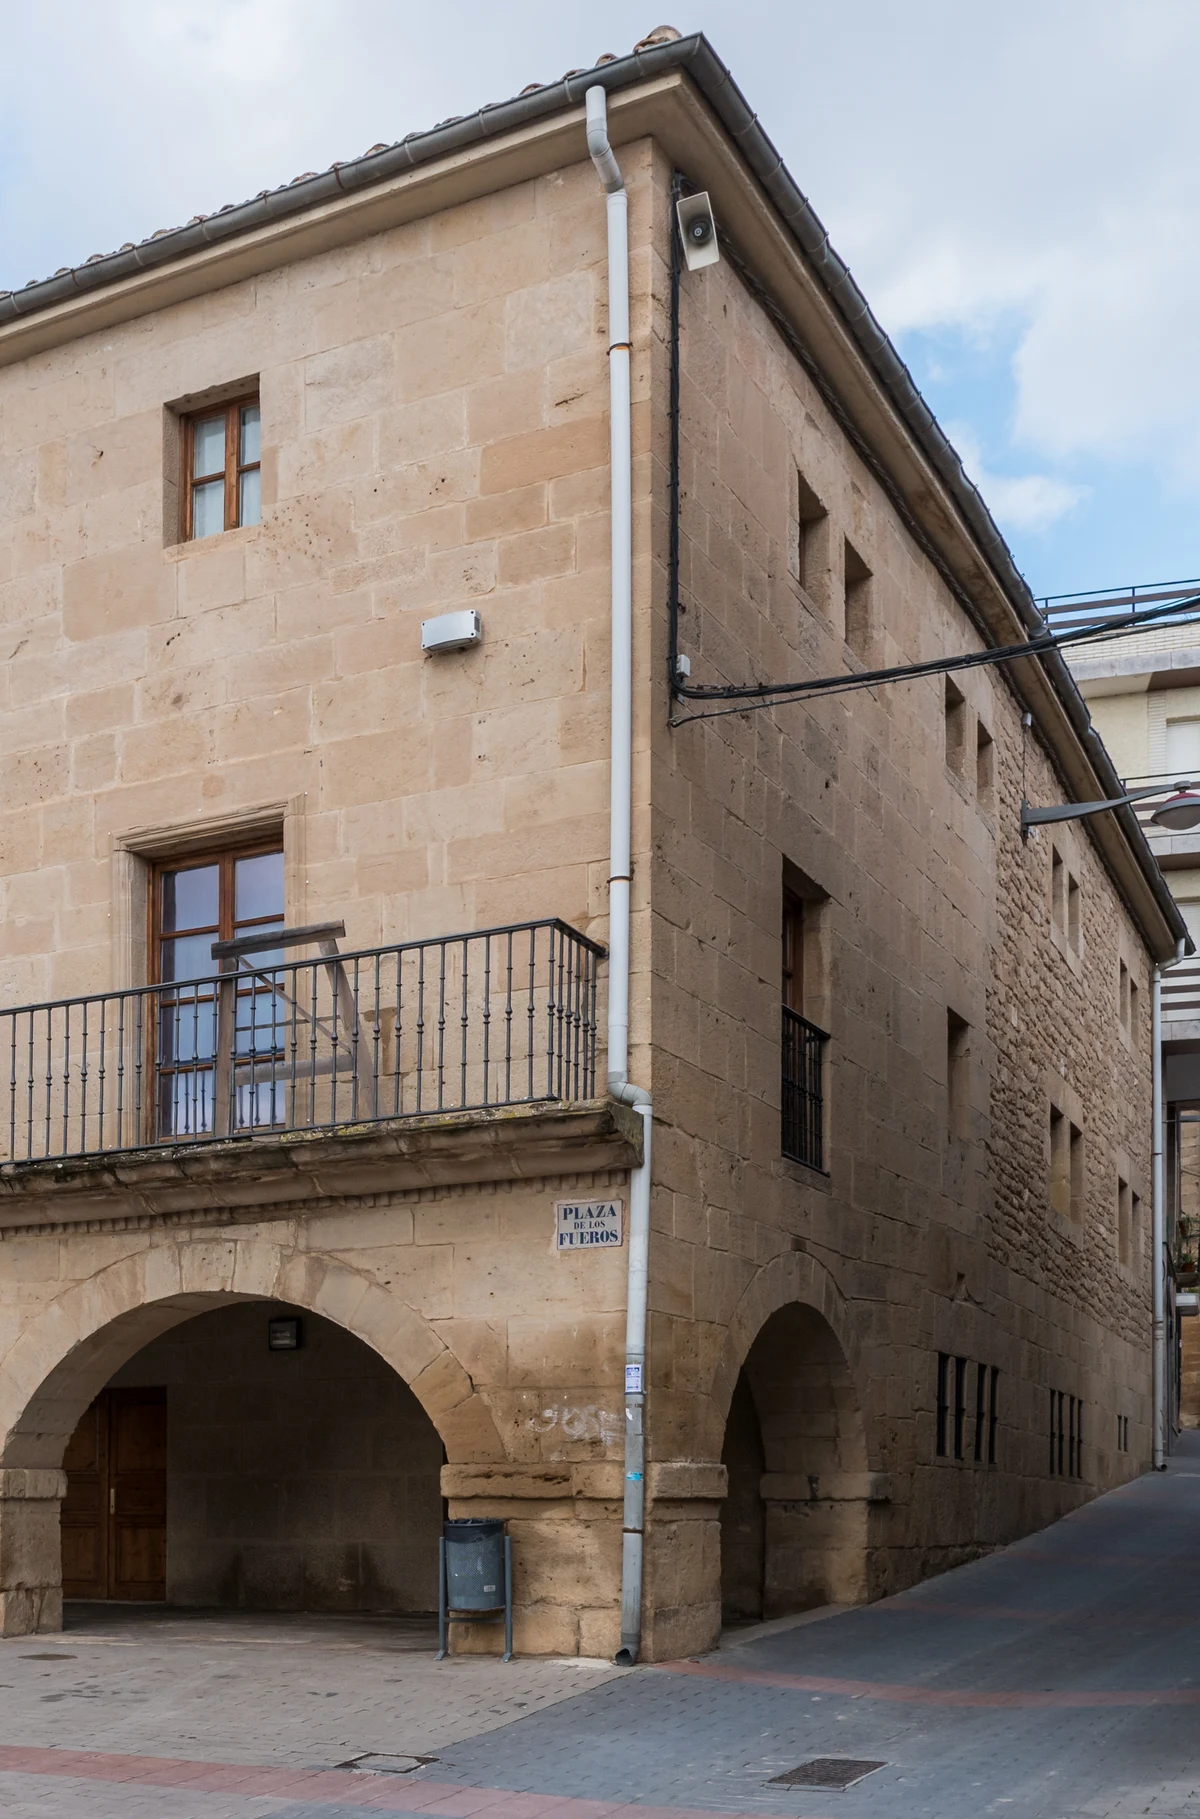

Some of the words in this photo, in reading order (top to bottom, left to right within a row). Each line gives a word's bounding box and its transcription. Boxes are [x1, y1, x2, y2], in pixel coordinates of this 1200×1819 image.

[563, 1205, 617, 1220] PLAZA
[574, 1222, 585, 1230] DE
[589, 1220, 605, 1229] LOS
[559, 1230, 618, 1246] FUEROS
